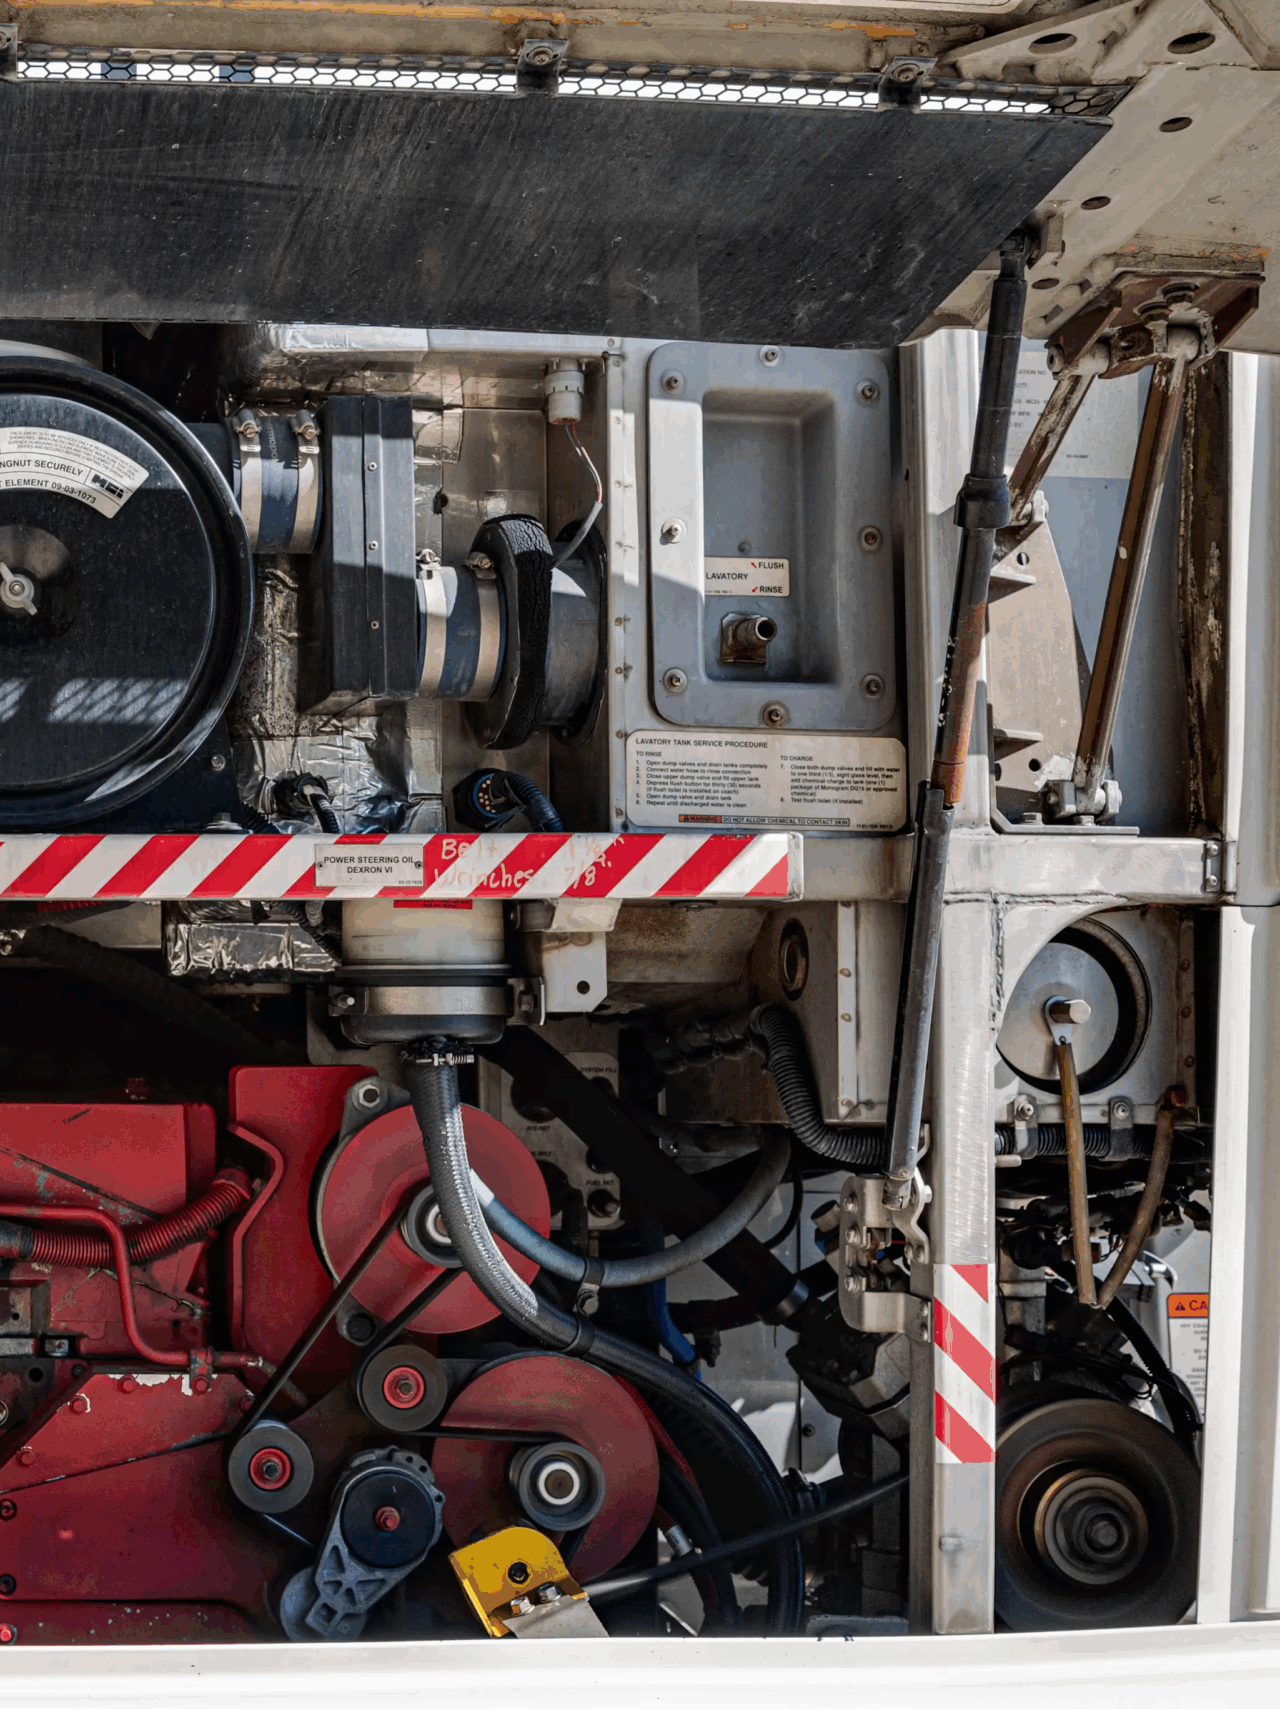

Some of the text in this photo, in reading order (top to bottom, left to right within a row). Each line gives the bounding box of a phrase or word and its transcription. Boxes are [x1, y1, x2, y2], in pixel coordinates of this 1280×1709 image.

[34, 459, 83, 476] SECURELY
[5, 479, 49, 488] ELEMENT
[51, 482, 97, 504] 09-03-1073
[705, 572, 748, 580] LAVATORY
[724, 741, 768, 749] PROCEDURE
[323, 856, 415, 864] POWER STEERING OIL
[347, 866, 393, 874] DEXRON VI
